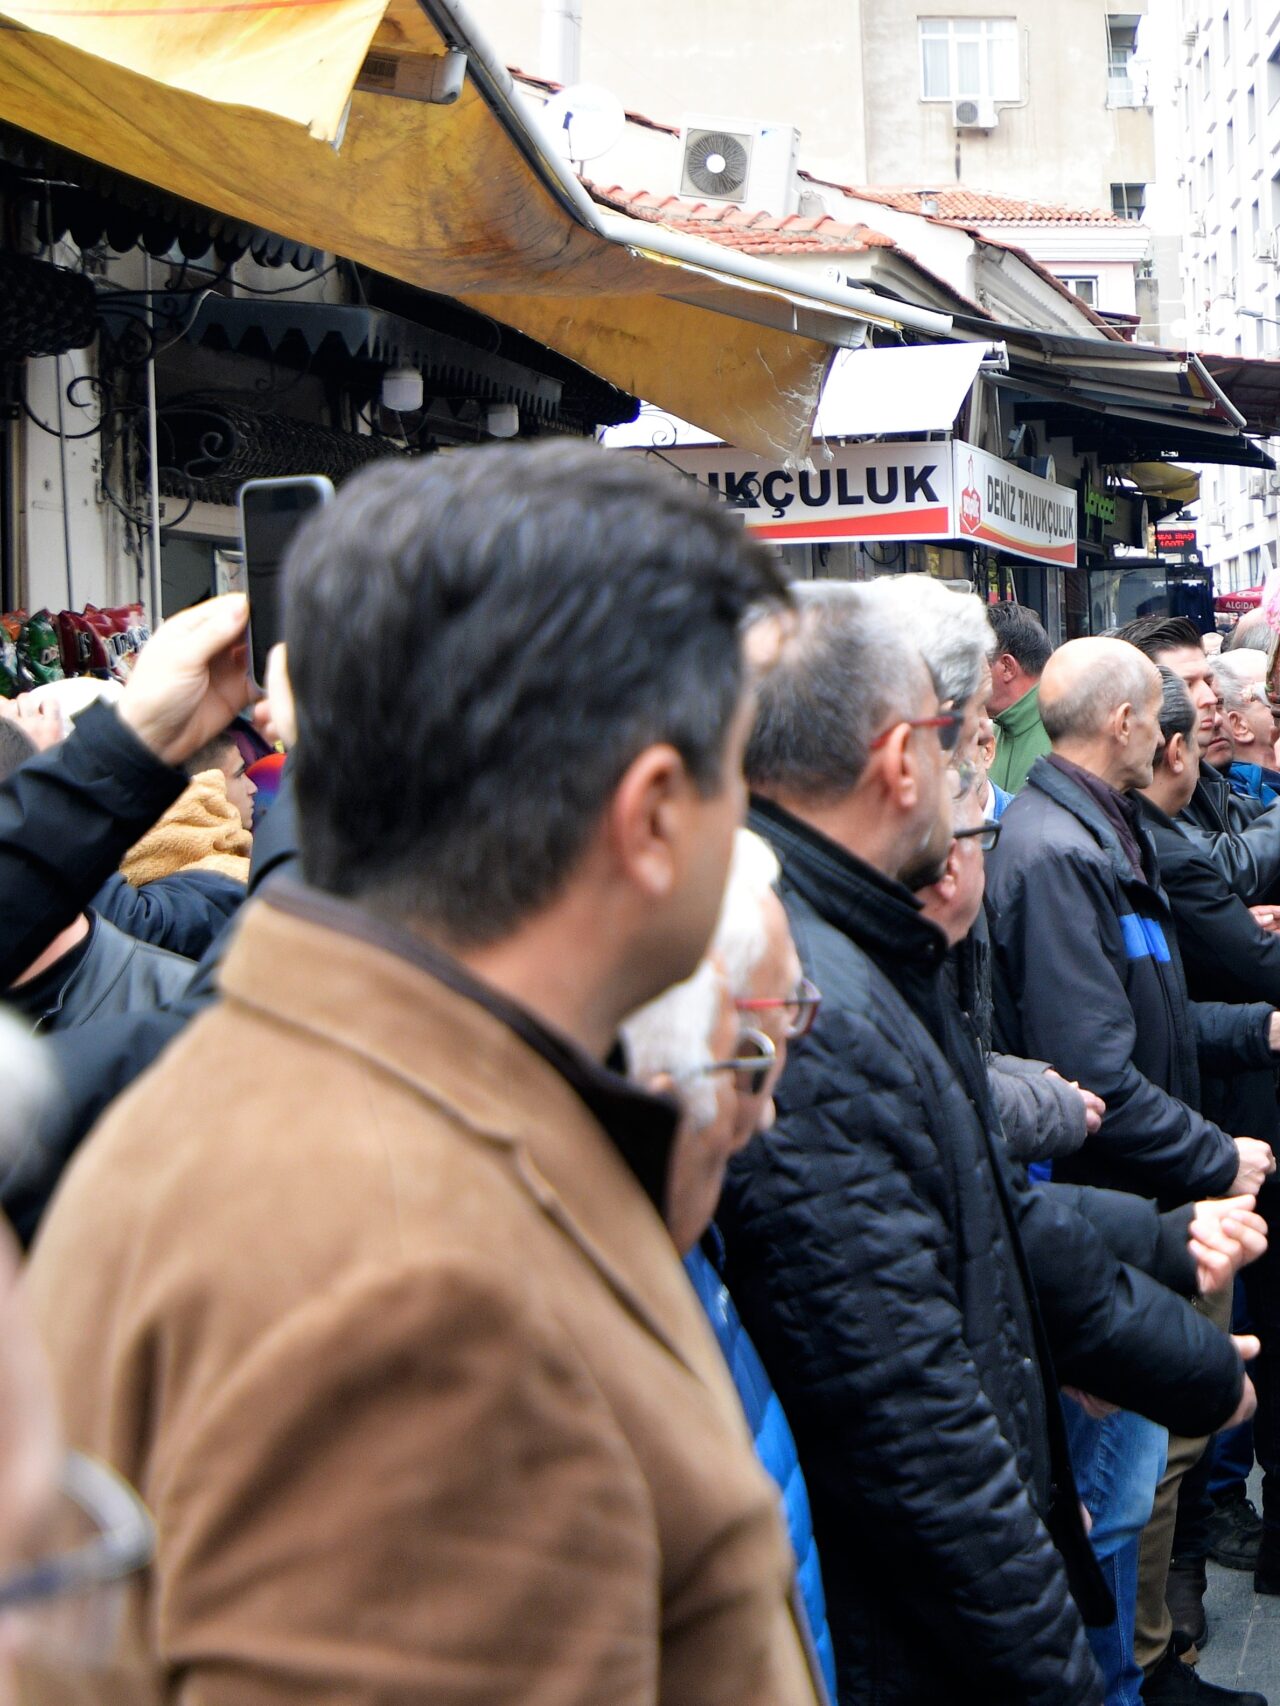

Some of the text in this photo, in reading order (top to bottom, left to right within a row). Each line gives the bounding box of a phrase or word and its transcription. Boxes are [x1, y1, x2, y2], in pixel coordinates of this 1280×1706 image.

[987, 474, 1016, 522] DENİZ
[1018, 489, 1074, 543] TAVUKÇULUK
[1225, 601, 1255, 610] ALGIDA
